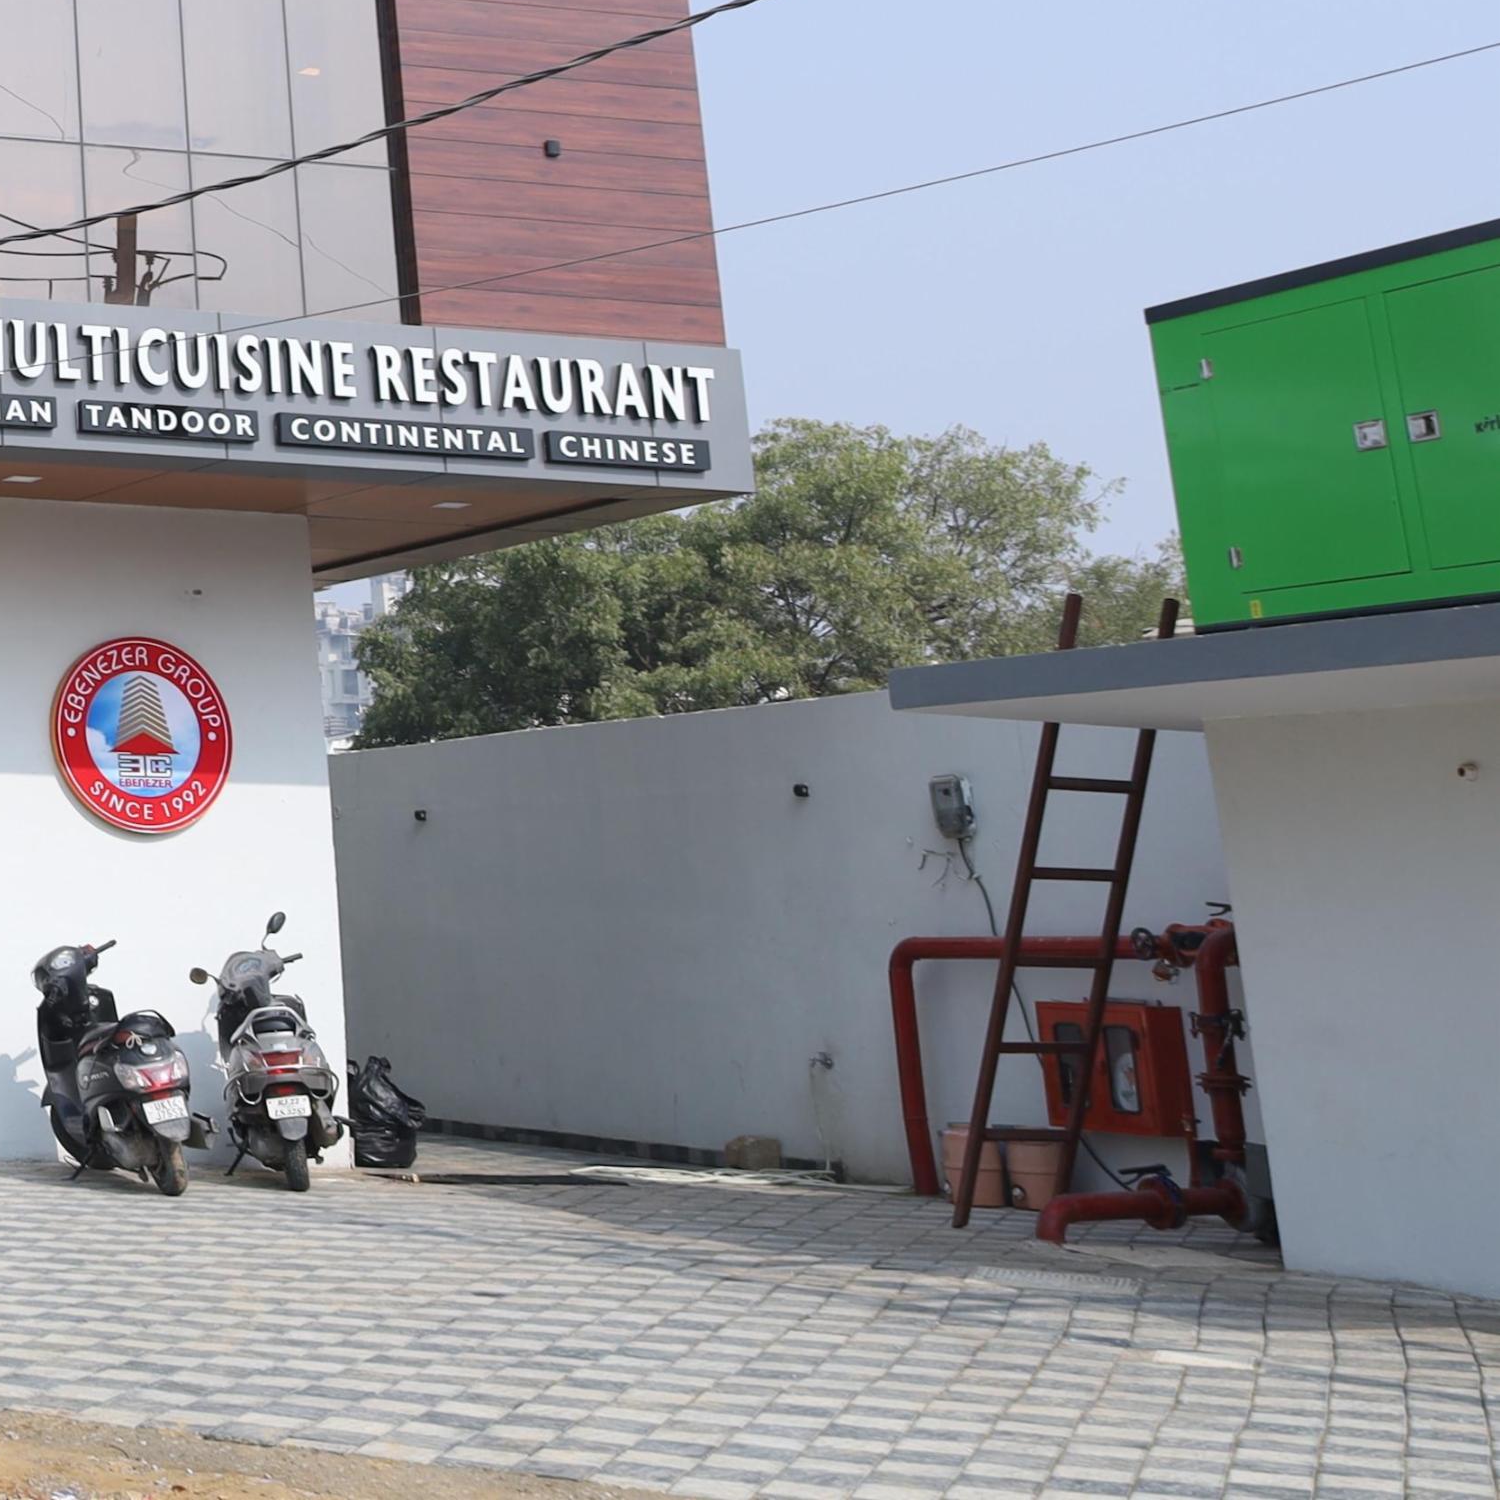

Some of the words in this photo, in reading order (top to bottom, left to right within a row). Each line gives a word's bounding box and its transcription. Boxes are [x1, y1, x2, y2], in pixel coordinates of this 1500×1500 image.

[369, 344, 715, 422] RESTAURANT
[84, 404, 256, 437] TANDOOR
[289, 418, 526, 455] CONTINENTAL
[557, 435, 697, 466] CHINESE
[64, 646, 148, 724] EBENEZER
[157, 653, 222, 728] GROUP
[90, 780, 154, 821] SINCE
[161, 780, 207, 818] 1992
[118, 778, 174, 789] EBENEZER
